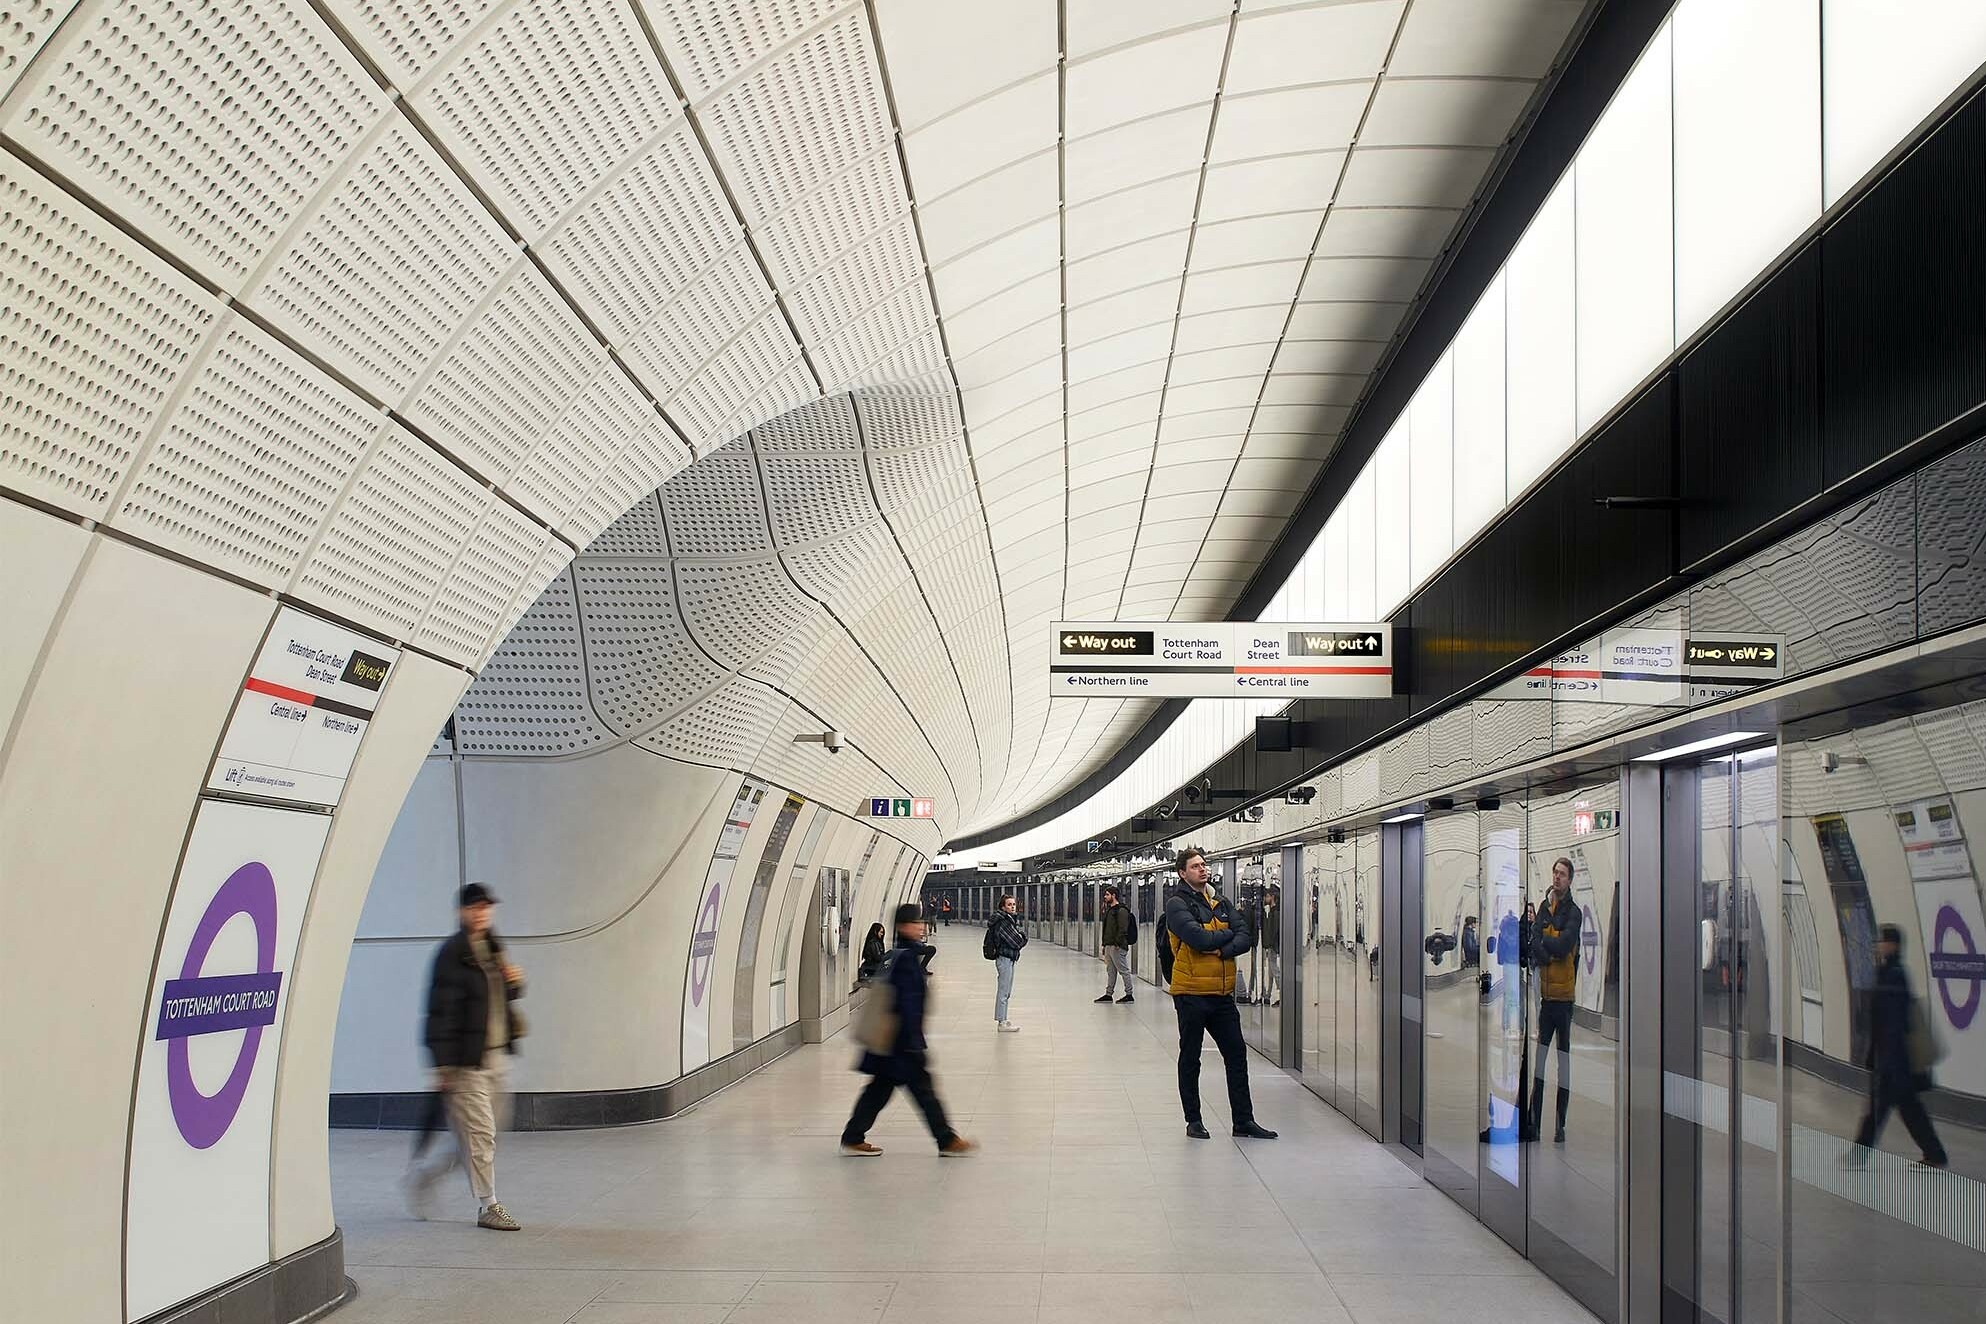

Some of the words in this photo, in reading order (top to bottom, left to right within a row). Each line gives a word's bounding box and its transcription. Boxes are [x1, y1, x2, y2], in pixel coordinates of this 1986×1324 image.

[1078, 635, 1109, 651] Way
[1111, 637, 1136, 649] out
[1162, 638, 1219, 648] Tottenham
[1253, 639, 1280, 648] Dean
[1305, 636, 1335, 652] Way
[1338, 638, 1363, 650] out
[286, 639, 317, 660] Tottenham
[315, 649, 332, 665] Court
[330, 654, 346, 669] Road
[1162, 650, 1193, 659] Court
[1196, 649, 1222, 659] Road
[1247, 650, 1280, 660] Street
[305, 665, 321, 680] Dean
[320, 669, 337, 685] Street
[353, 658, 369, 680] Way
[366, 666, 380, 680] out
[1078, 676, 1127, 686] Northern
[1129, 676, 1149, 686] line
[1248, 677, 1286, 687] Central
[1290, 677, 1309, 687] line
[270, 702, 292, 719] Central
[290, 706, 301, 722] line
[321, 714, 345, 732] Northern
[225, 768, 238, 783] Lift
[165, 994, 222, 1020] TOTTENHAM
[222, 991, 252, 1013] COURT
[252, 990, 276, 1009] ROAD
